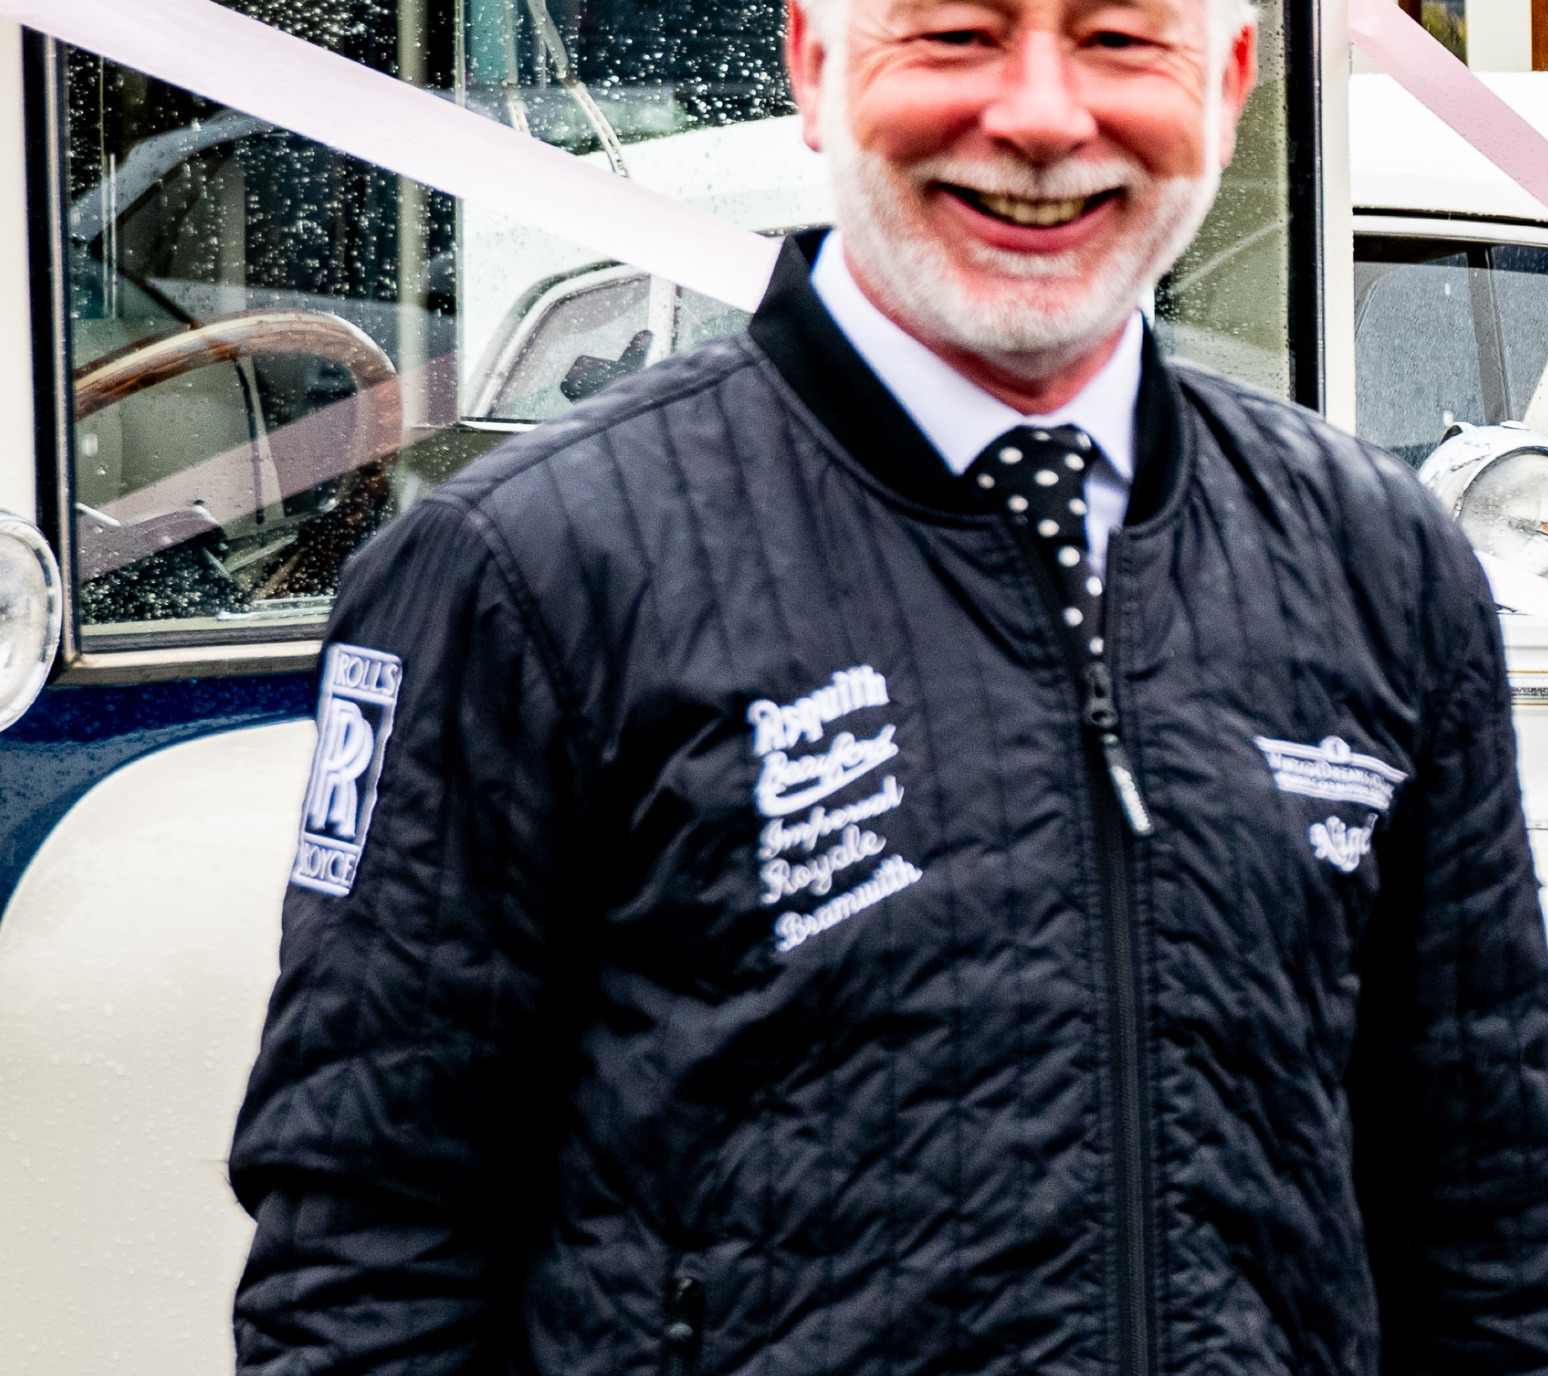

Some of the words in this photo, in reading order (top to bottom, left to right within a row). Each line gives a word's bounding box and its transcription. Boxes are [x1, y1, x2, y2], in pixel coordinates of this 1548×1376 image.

[336, 653, 398, 696] ROLLS
[747, 664, 890, 756] Asquith
[302, 841, 356, 886] ROYCE
[760, 824, 887, 904] Royale
